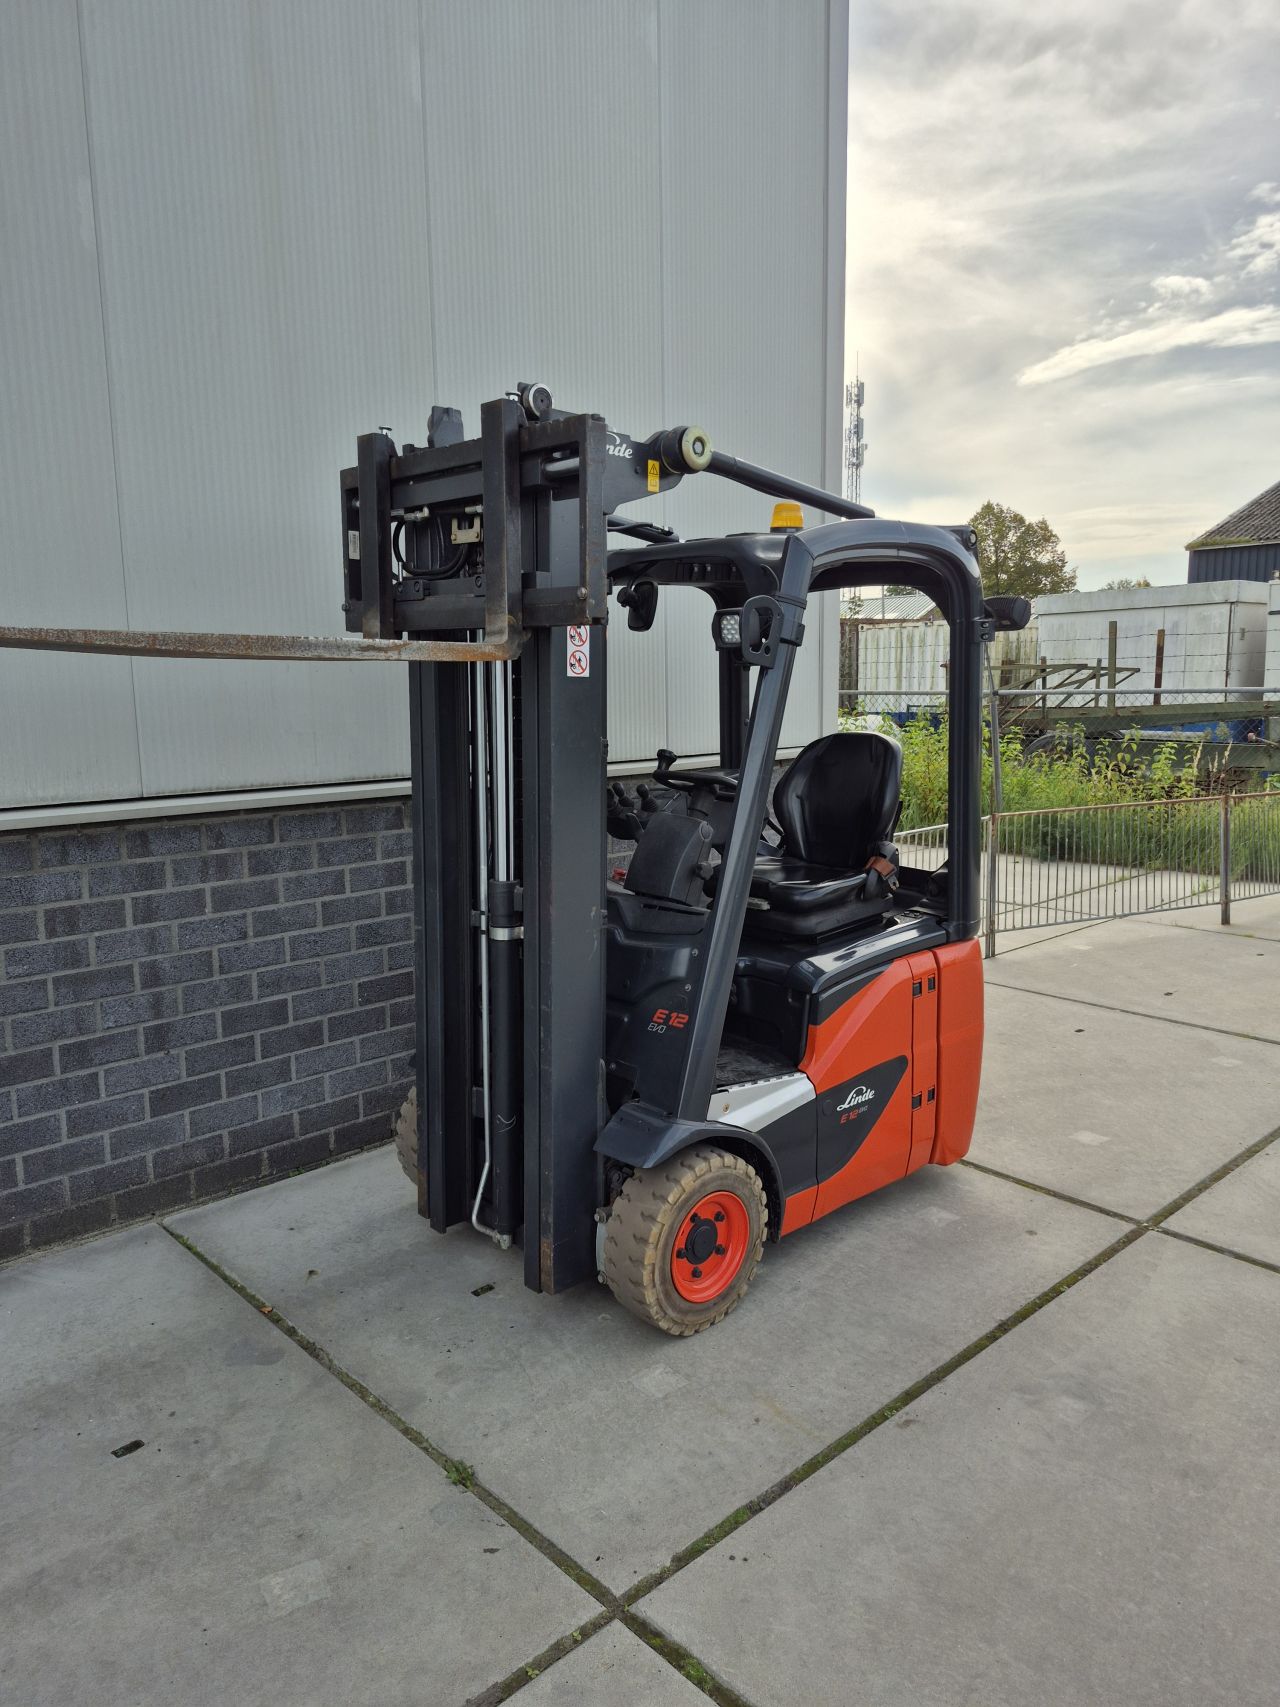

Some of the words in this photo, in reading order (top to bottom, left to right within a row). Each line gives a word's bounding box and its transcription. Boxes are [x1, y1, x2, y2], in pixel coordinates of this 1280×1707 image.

[606, 432, 633, 458] nde
[647, 1022, 667, 1034] EVO
[836, 1086, 875, 1111] Linde
